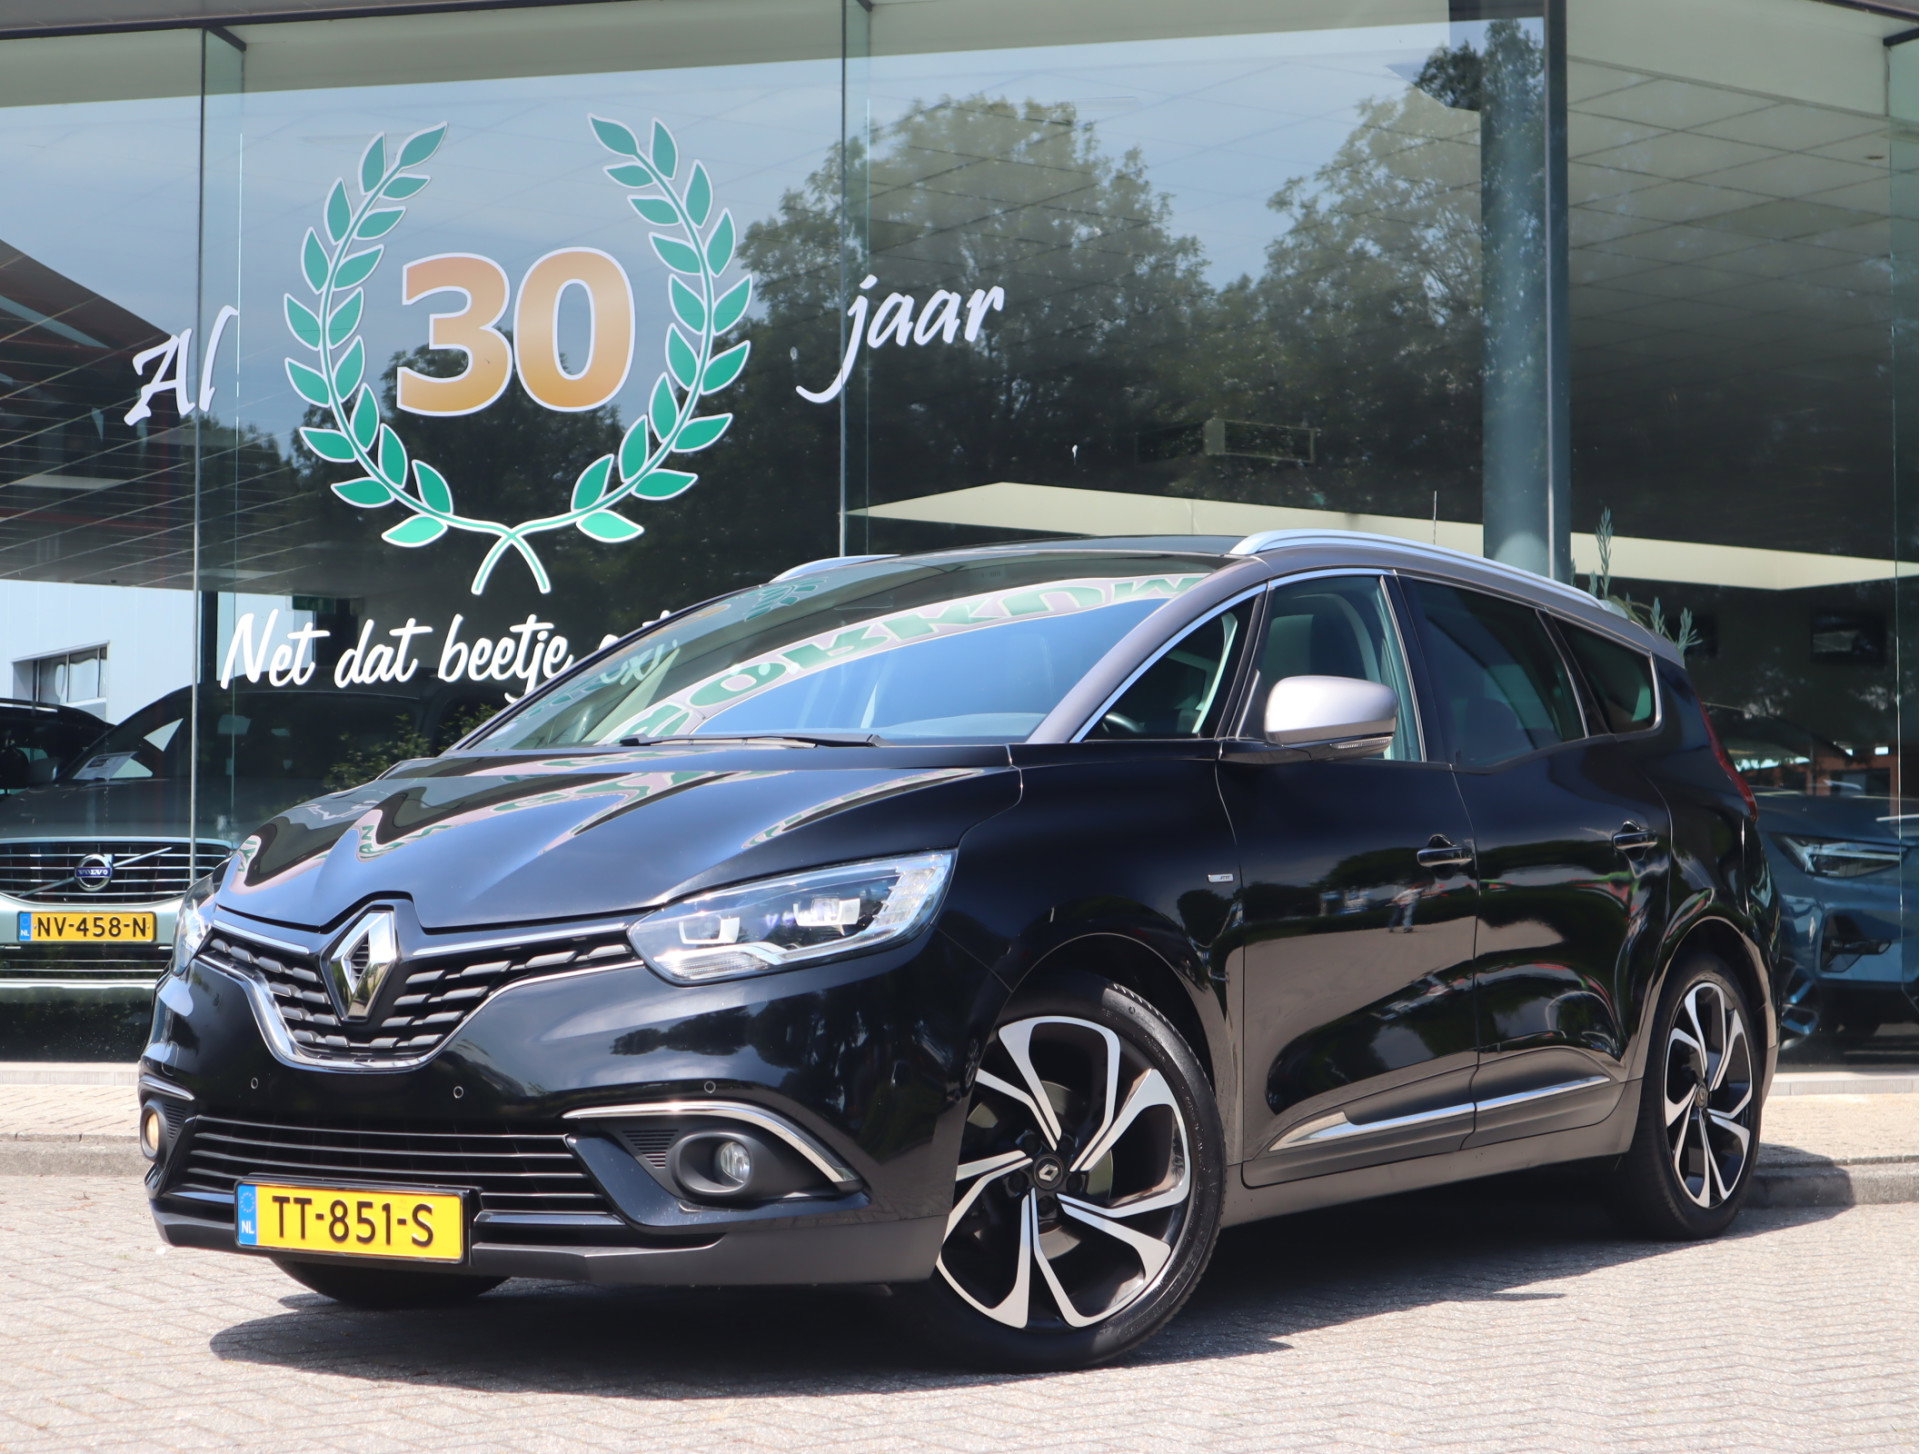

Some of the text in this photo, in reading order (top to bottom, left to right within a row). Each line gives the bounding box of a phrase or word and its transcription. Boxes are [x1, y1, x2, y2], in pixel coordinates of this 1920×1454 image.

[124, 246, 1005, 426] Al 30 jaar
[220, 608, 331, 690] Net
[334, 617, 433, 689] dat
[437, 613, 575, 706] beetje
[77, 867, 109, 877] VOLVO
[20, 929, 30, 937] NL
[37, 916, 147, 938] NV-458-N
[241, 1219, 255, 1235] NL
[271, 1195, 435, 1248] TT-851-S
